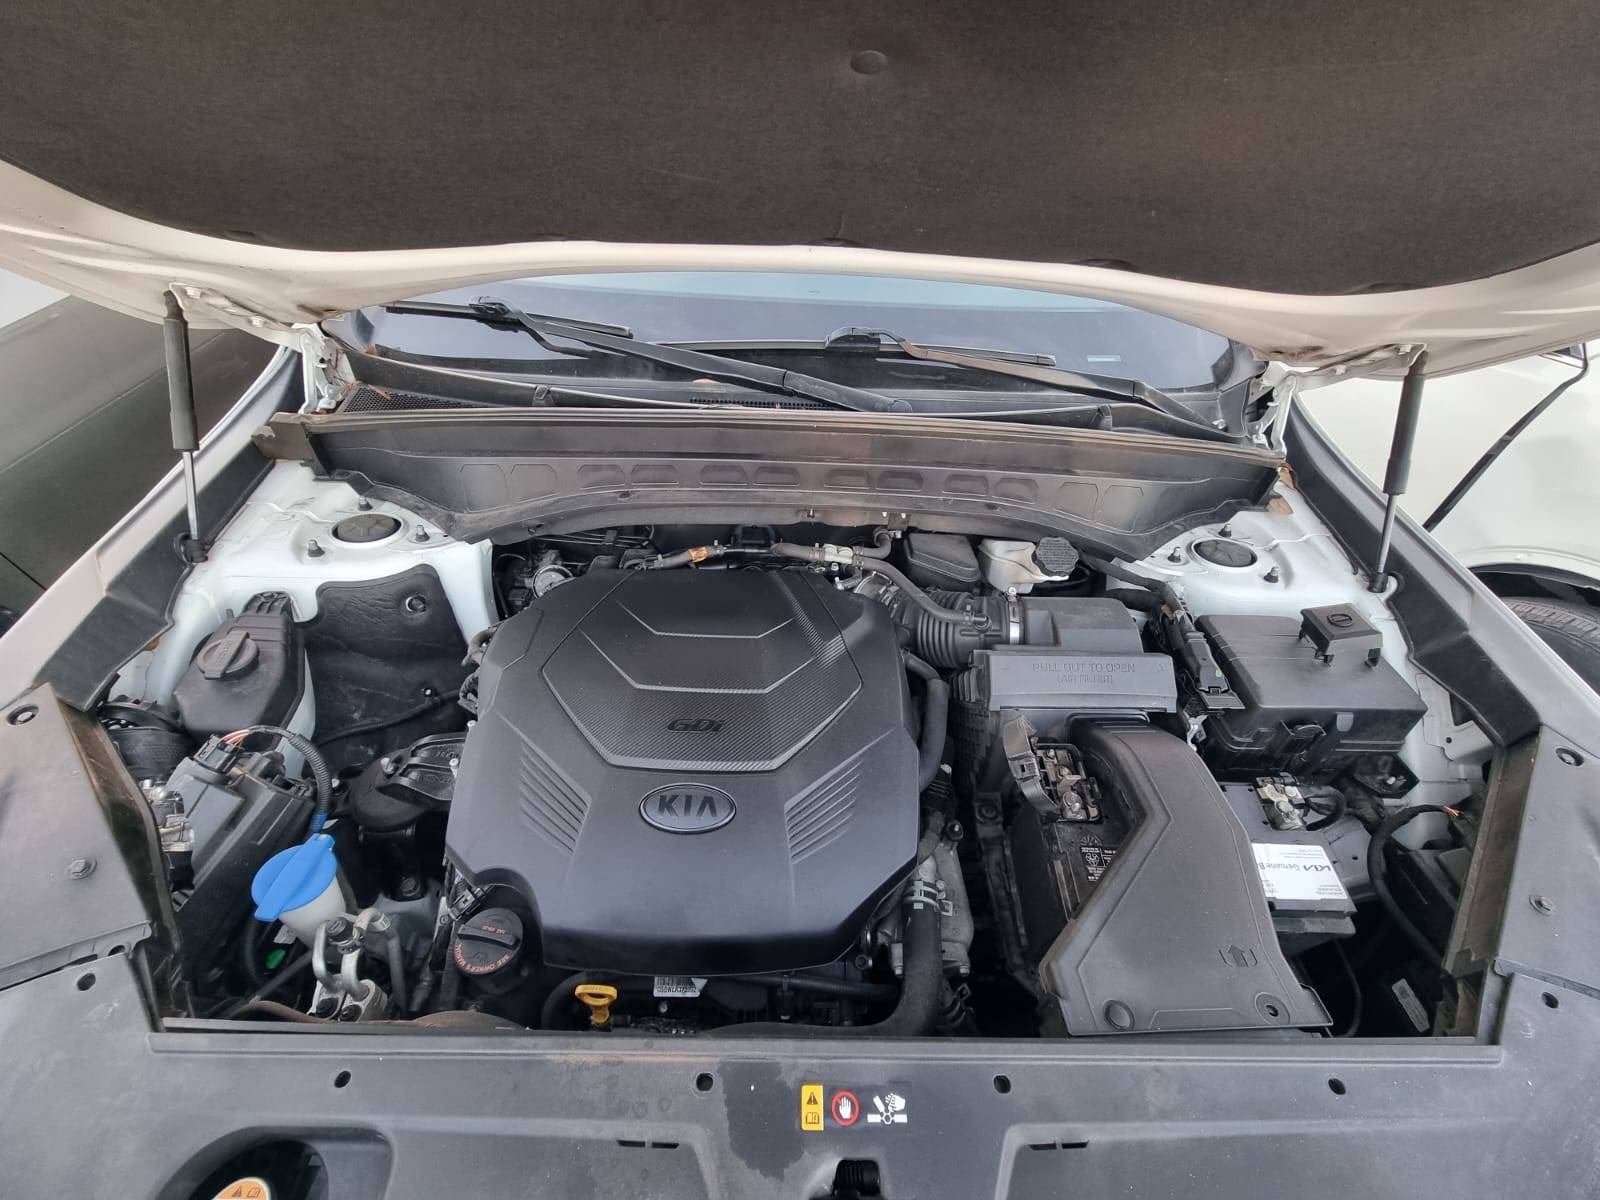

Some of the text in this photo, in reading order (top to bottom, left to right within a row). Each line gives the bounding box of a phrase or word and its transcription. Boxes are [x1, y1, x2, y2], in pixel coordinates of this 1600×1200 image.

[1032, 662, 1136, 673] PULL OUT TO OPEN
[667, 719, 725, 733] GDi
[658, 794, 717, 817] KIA
[1265, 862, 1300, 871] Genuine
[1303, 864, 1331, 872] KIA
